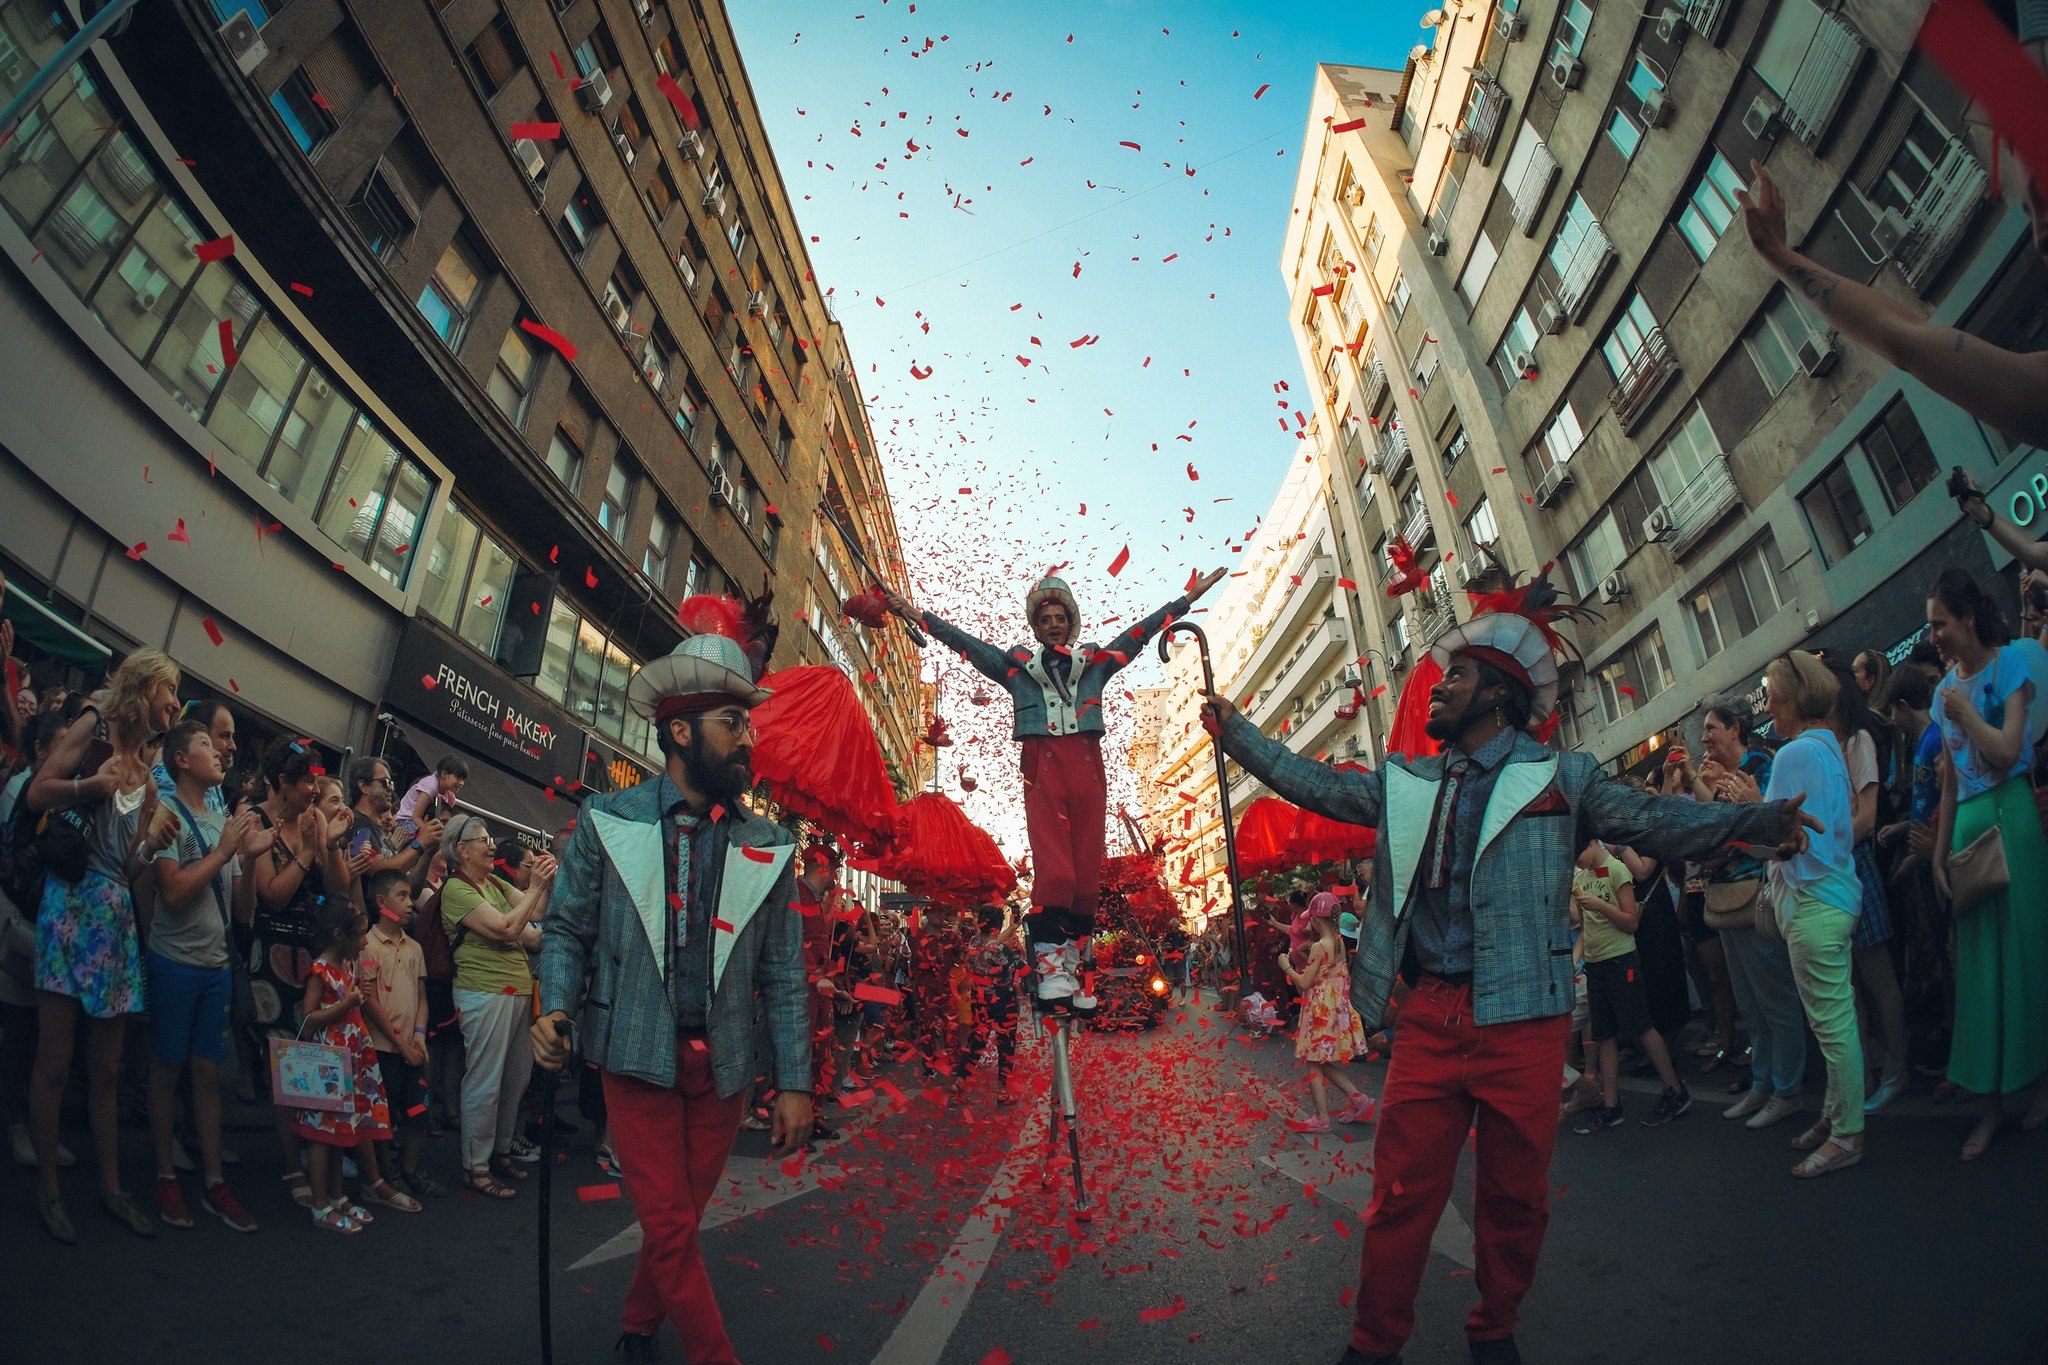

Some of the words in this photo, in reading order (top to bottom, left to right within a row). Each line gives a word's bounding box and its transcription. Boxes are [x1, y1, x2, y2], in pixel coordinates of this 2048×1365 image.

[2009, 470, 2048, 526] OP
[436, 662, 500, 719] FRENCH
[504, 705, 557, 751] BAKERY
[1745, 686, 1764, 704] ONT
[449, 698, 488, 732] Pâtisserie
[487, 723, 503, 740] fine
[502, 736, 520, 748] pure
